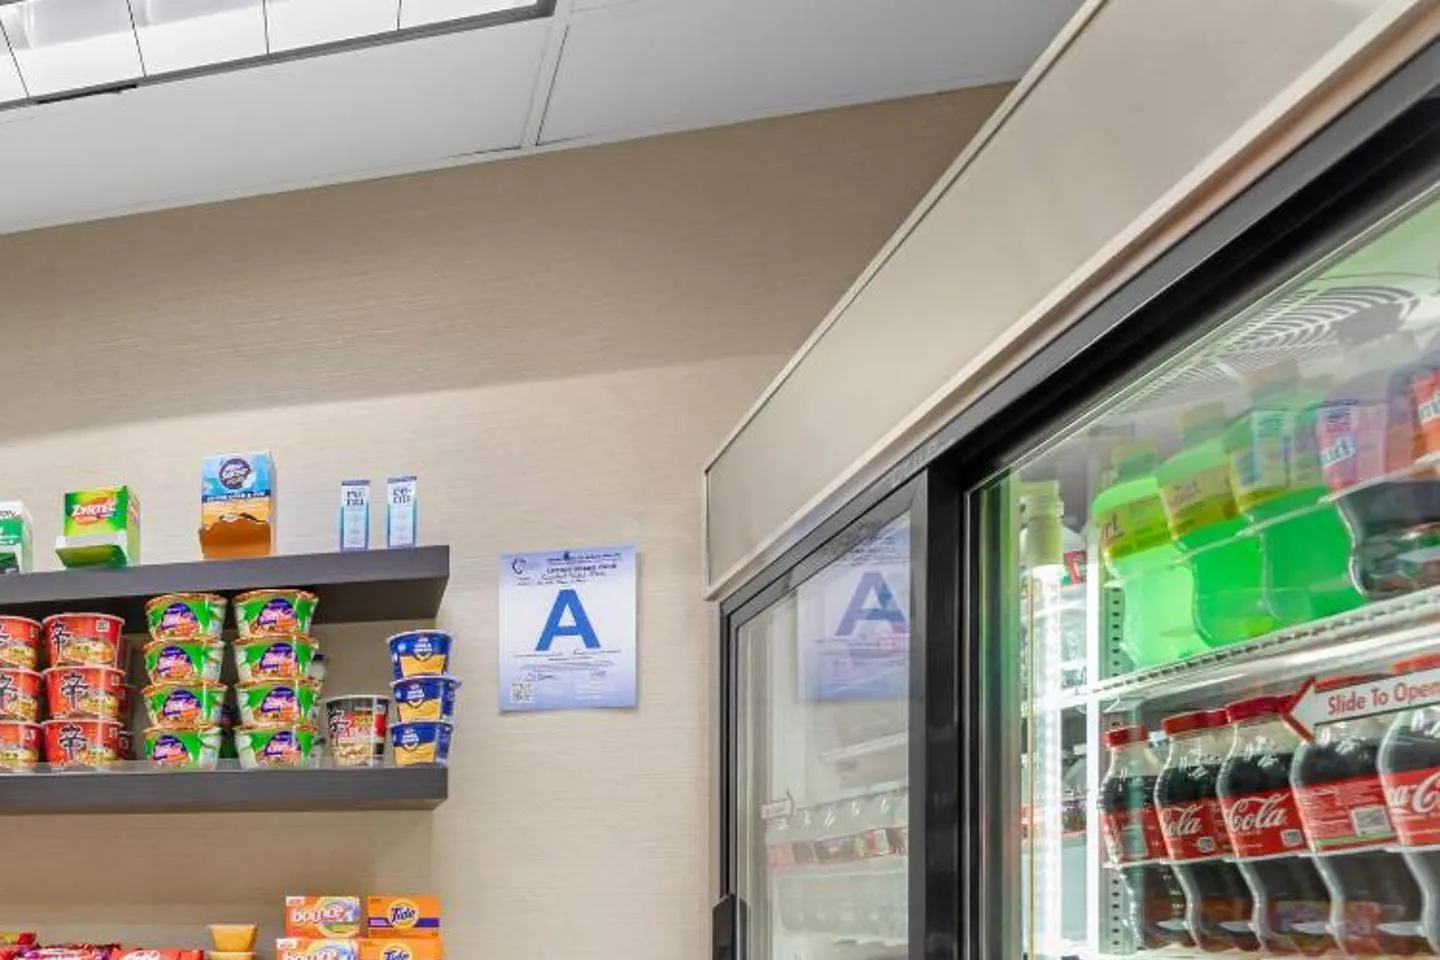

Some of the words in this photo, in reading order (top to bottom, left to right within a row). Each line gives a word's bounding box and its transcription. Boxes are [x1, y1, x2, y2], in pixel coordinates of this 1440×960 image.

[535, 588, 602, 652] A
[1327, 691, 1367, 715] Slide
[1370, 686, 1389, 707] To
[1226, 793, 1291, 833] Cola
[291, 905, 344, 923] bounce
[390, 906, 416, 923] Tide
